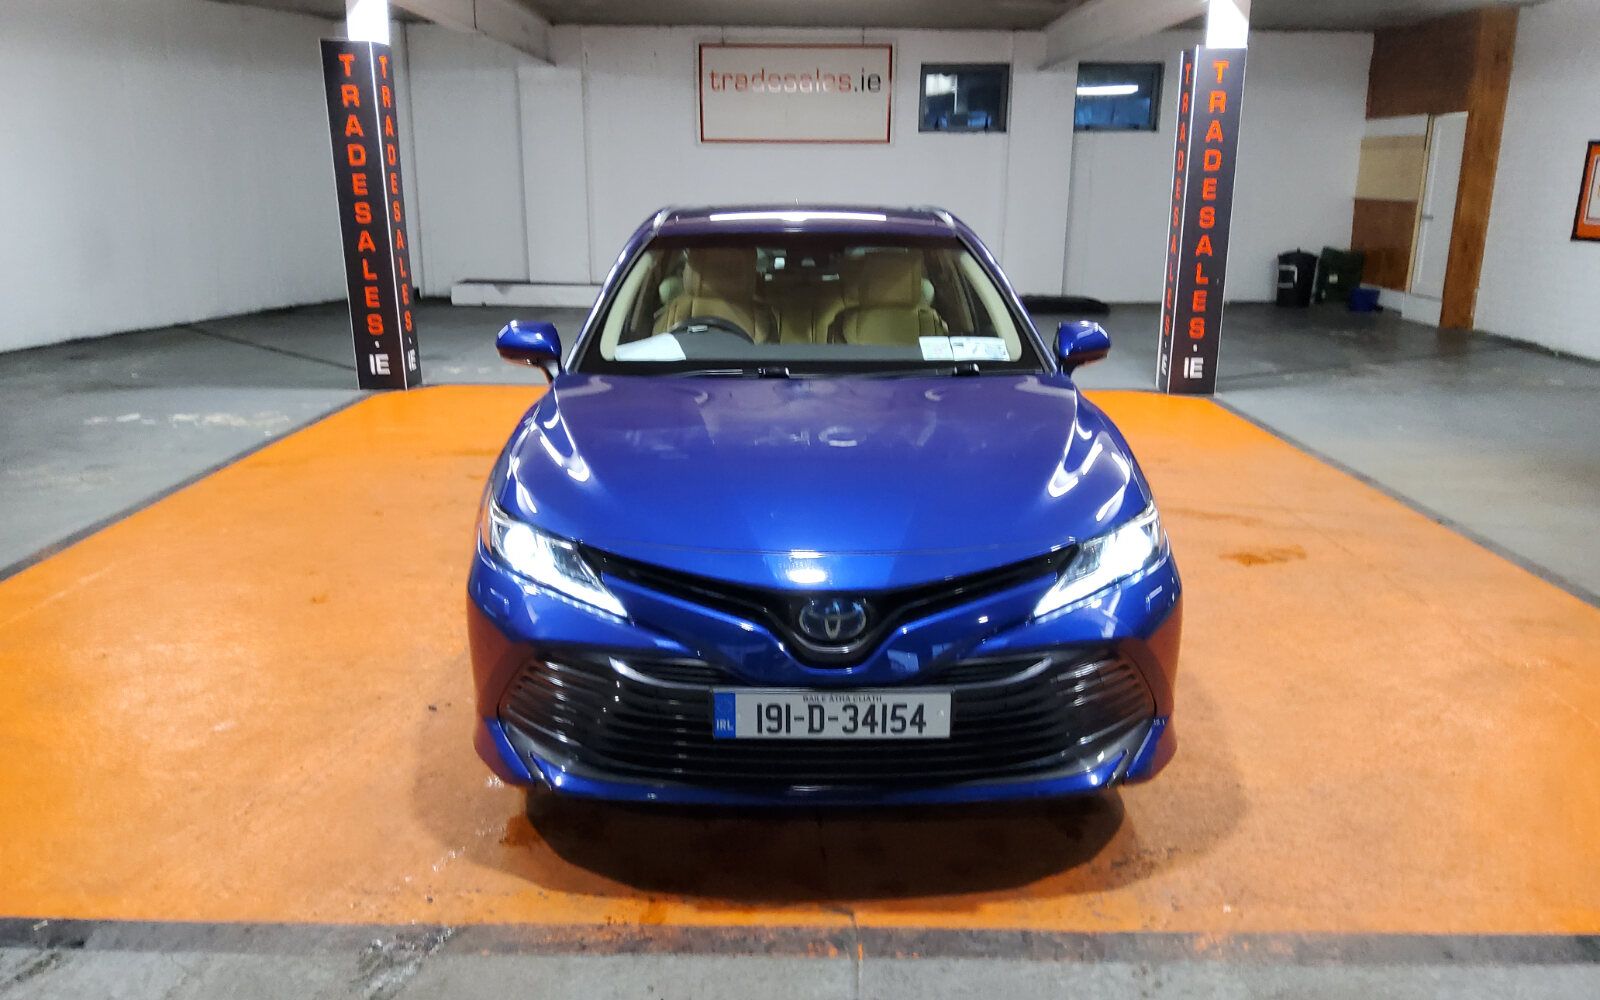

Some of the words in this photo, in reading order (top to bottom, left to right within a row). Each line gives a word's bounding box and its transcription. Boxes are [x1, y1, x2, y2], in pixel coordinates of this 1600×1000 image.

[709, 67, 881, 93] tradesales.ie
[338, 53, 391, 376] TRADESALES.IE
[379, 55, 417, 372] TRADESALES.IE
[1182, 60, 1229, 379] TRADESALES.IE
[716, 718, 734, 731] IRL
[756, 703, 927, 735] 191-D-34154
